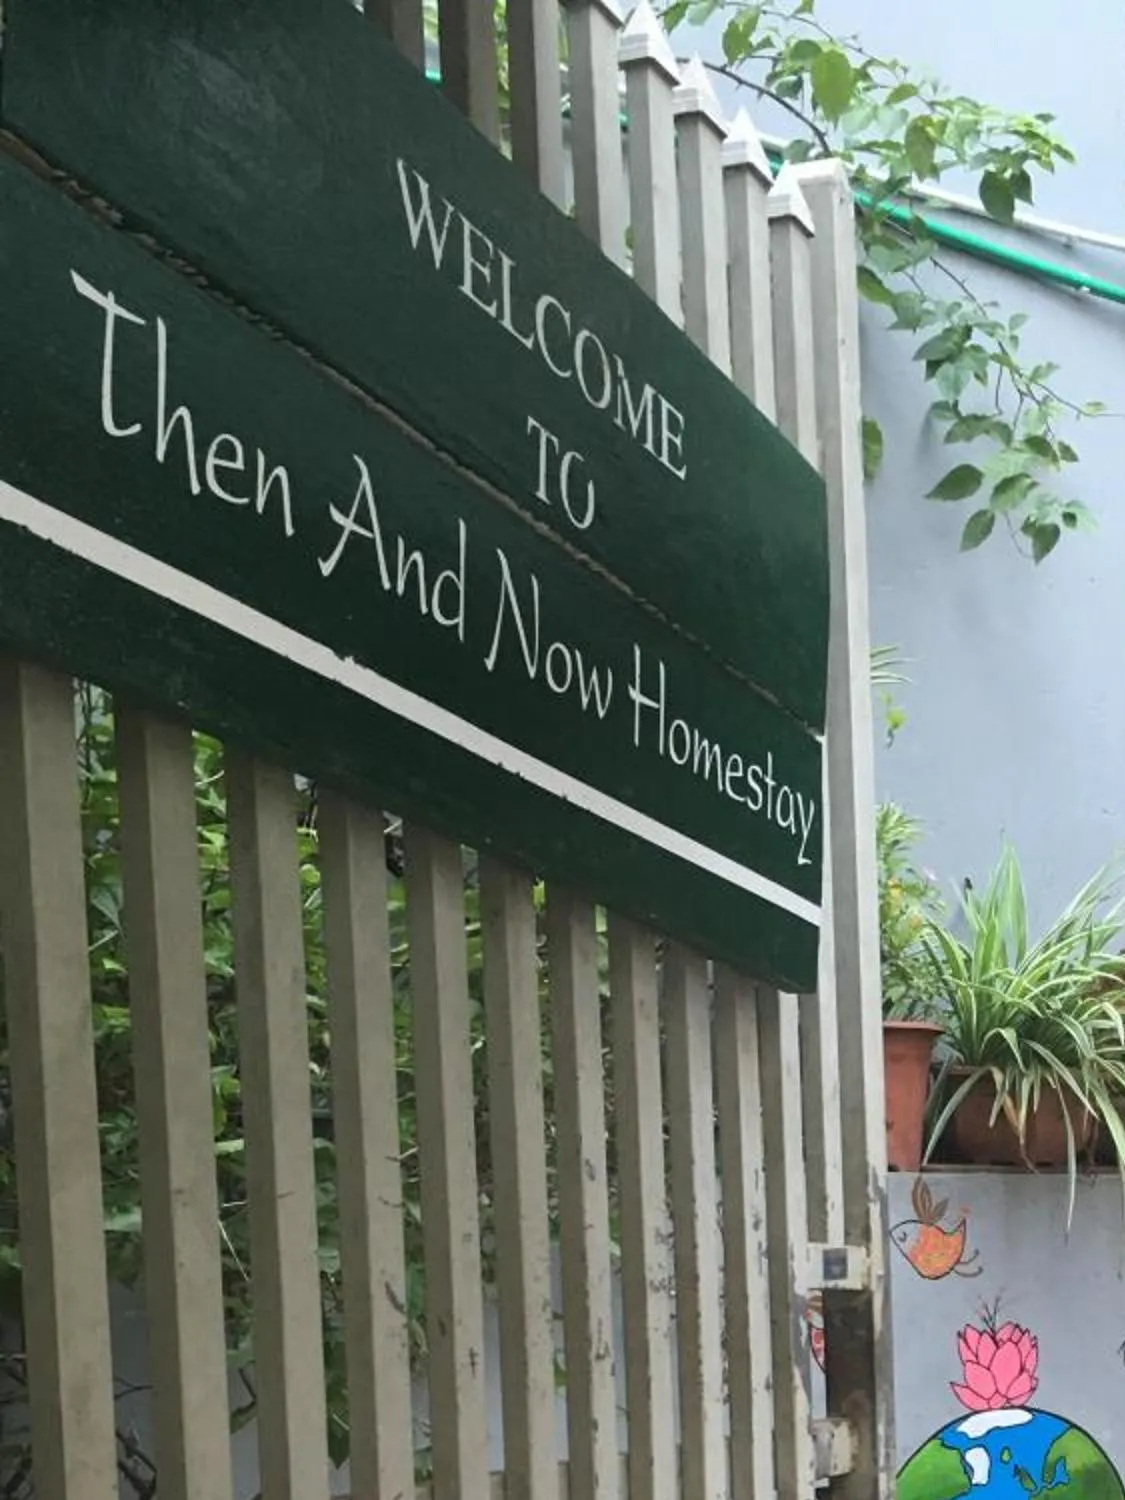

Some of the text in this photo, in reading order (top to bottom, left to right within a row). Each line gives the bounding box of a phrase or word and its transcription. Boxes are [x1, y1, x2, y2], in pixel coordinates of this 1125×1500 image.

[397, 158, 688, 481] WELCOME
[526, 416, 595, 530] TO
[70, 268, 815, 865] Then And Now Homestay
